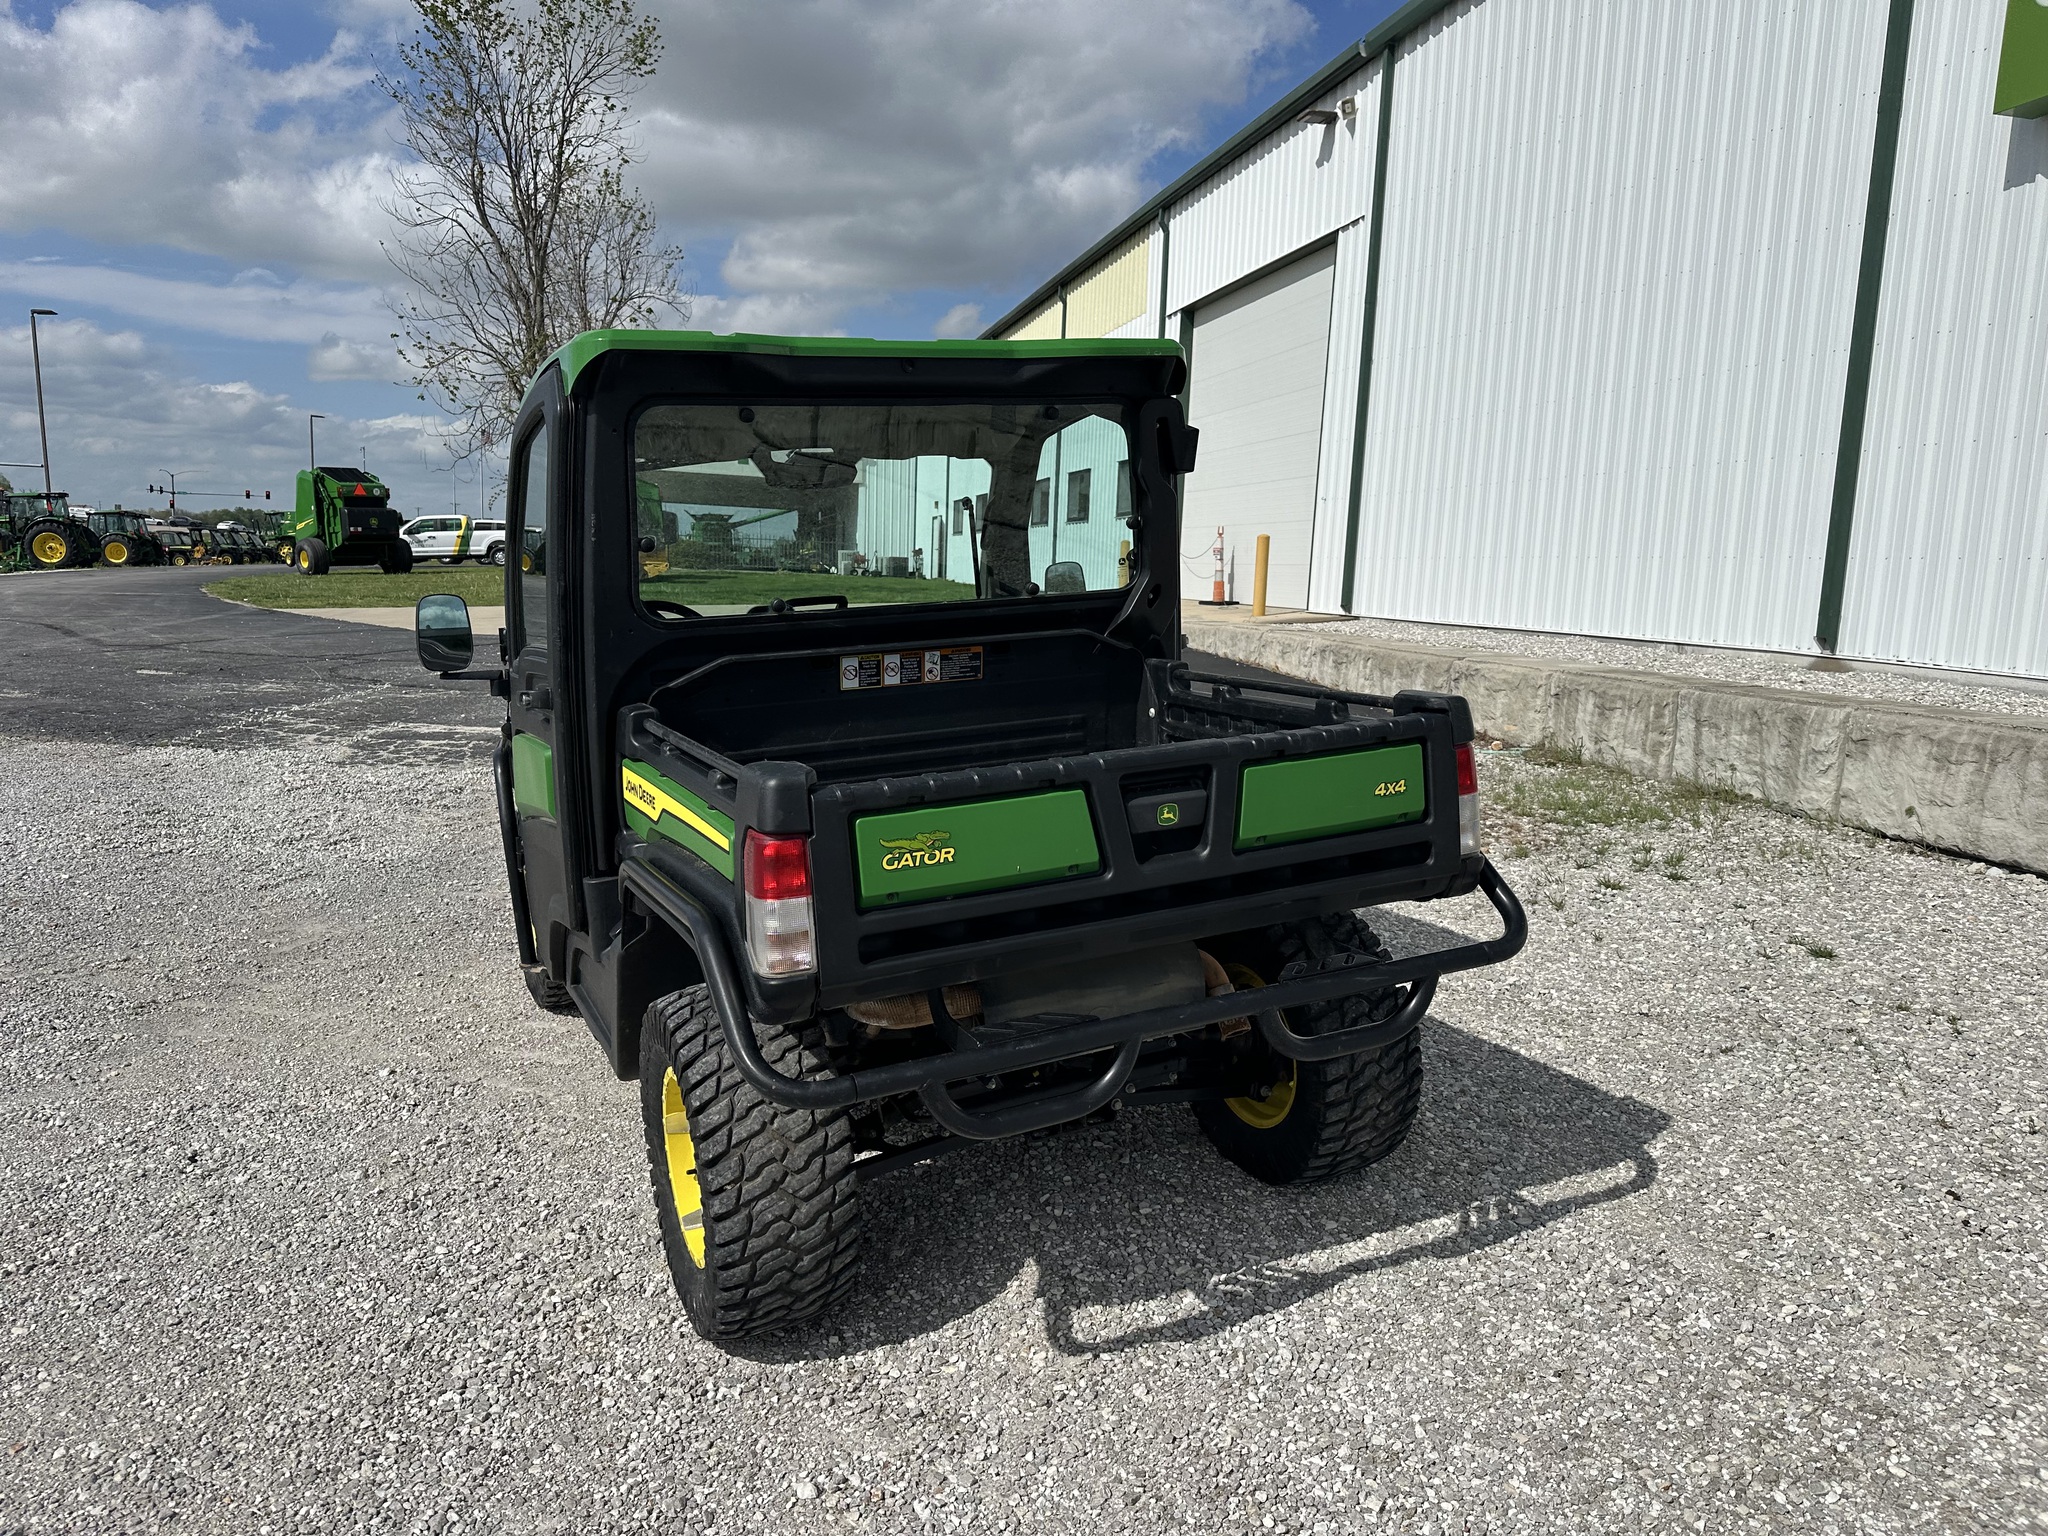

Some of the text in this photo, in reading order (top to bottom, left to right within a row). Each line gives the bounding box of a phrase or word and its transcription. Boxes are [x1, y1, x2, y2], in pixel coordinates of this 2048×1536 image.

[625, 776, 656, 810] JOHN DEERE
[882, 847, 955, 871] GATOR
